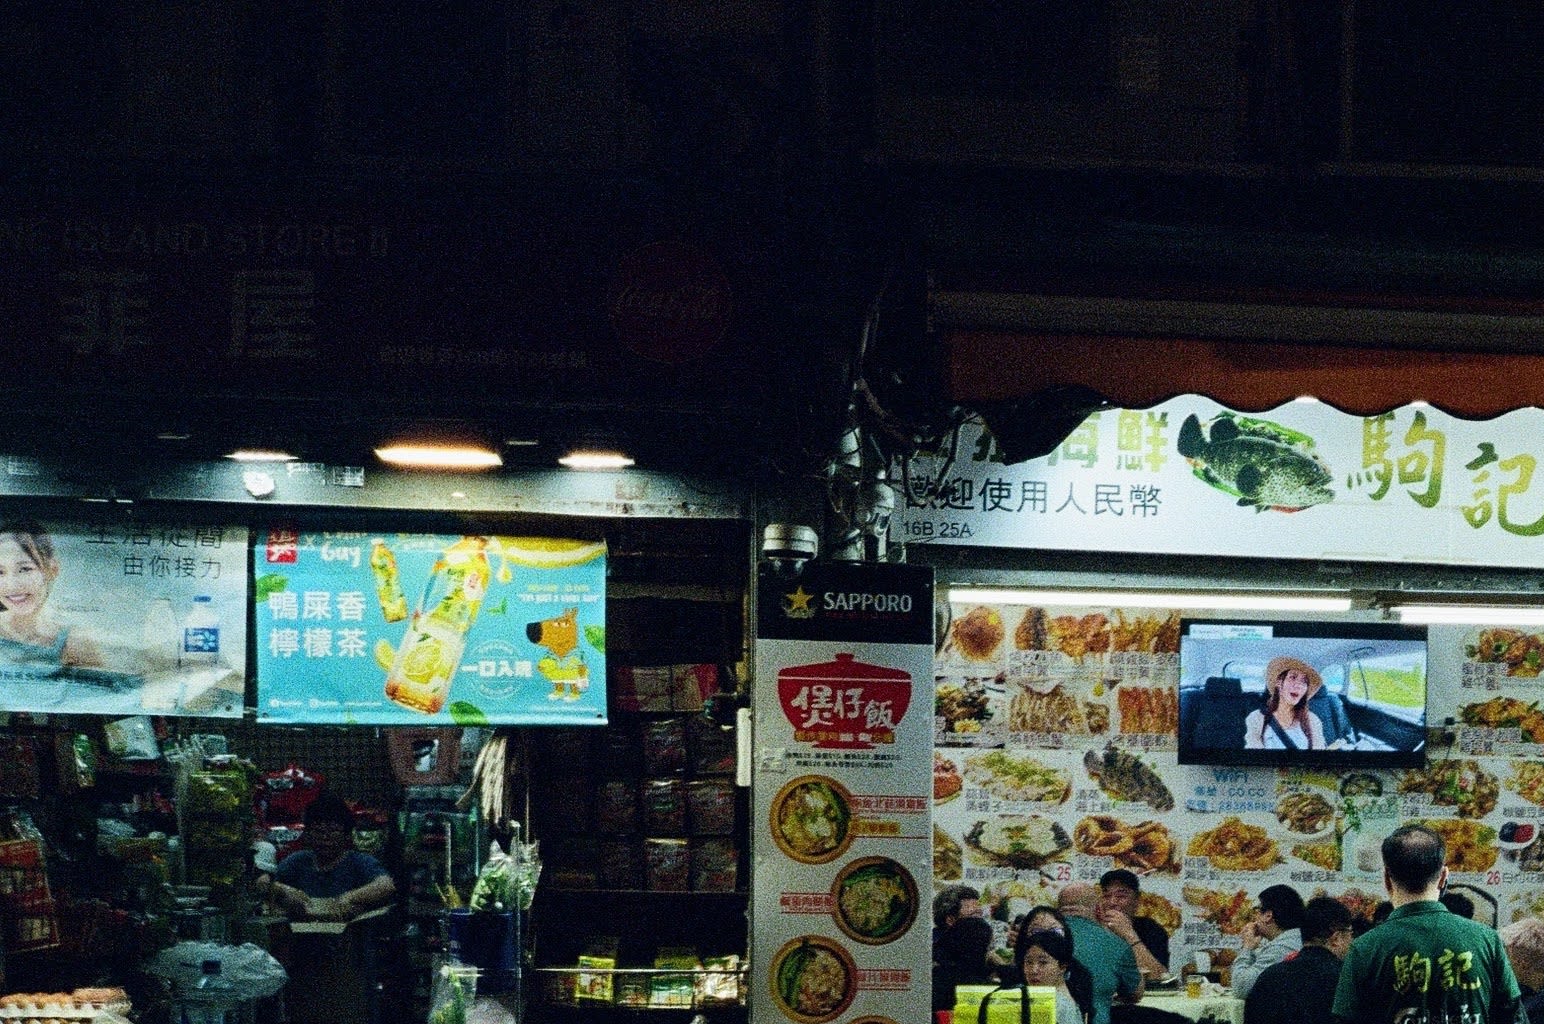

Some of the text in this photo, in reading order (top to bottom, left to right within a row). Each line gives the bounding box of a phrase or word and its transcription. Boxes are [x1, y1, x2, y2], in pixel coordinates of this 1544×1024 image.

[320, 541, 361, 568] Guy
[124, 556, 222, 579] 由你接力
[823, 591, 913, 613] SAPPORO
[269, 628, 367, 659] 檸檬茶
[791, 684, 896, 730] 煲仔飯
[1057, 866, 1071, 881] 25
[1486, 871, 1501, 886] 26
